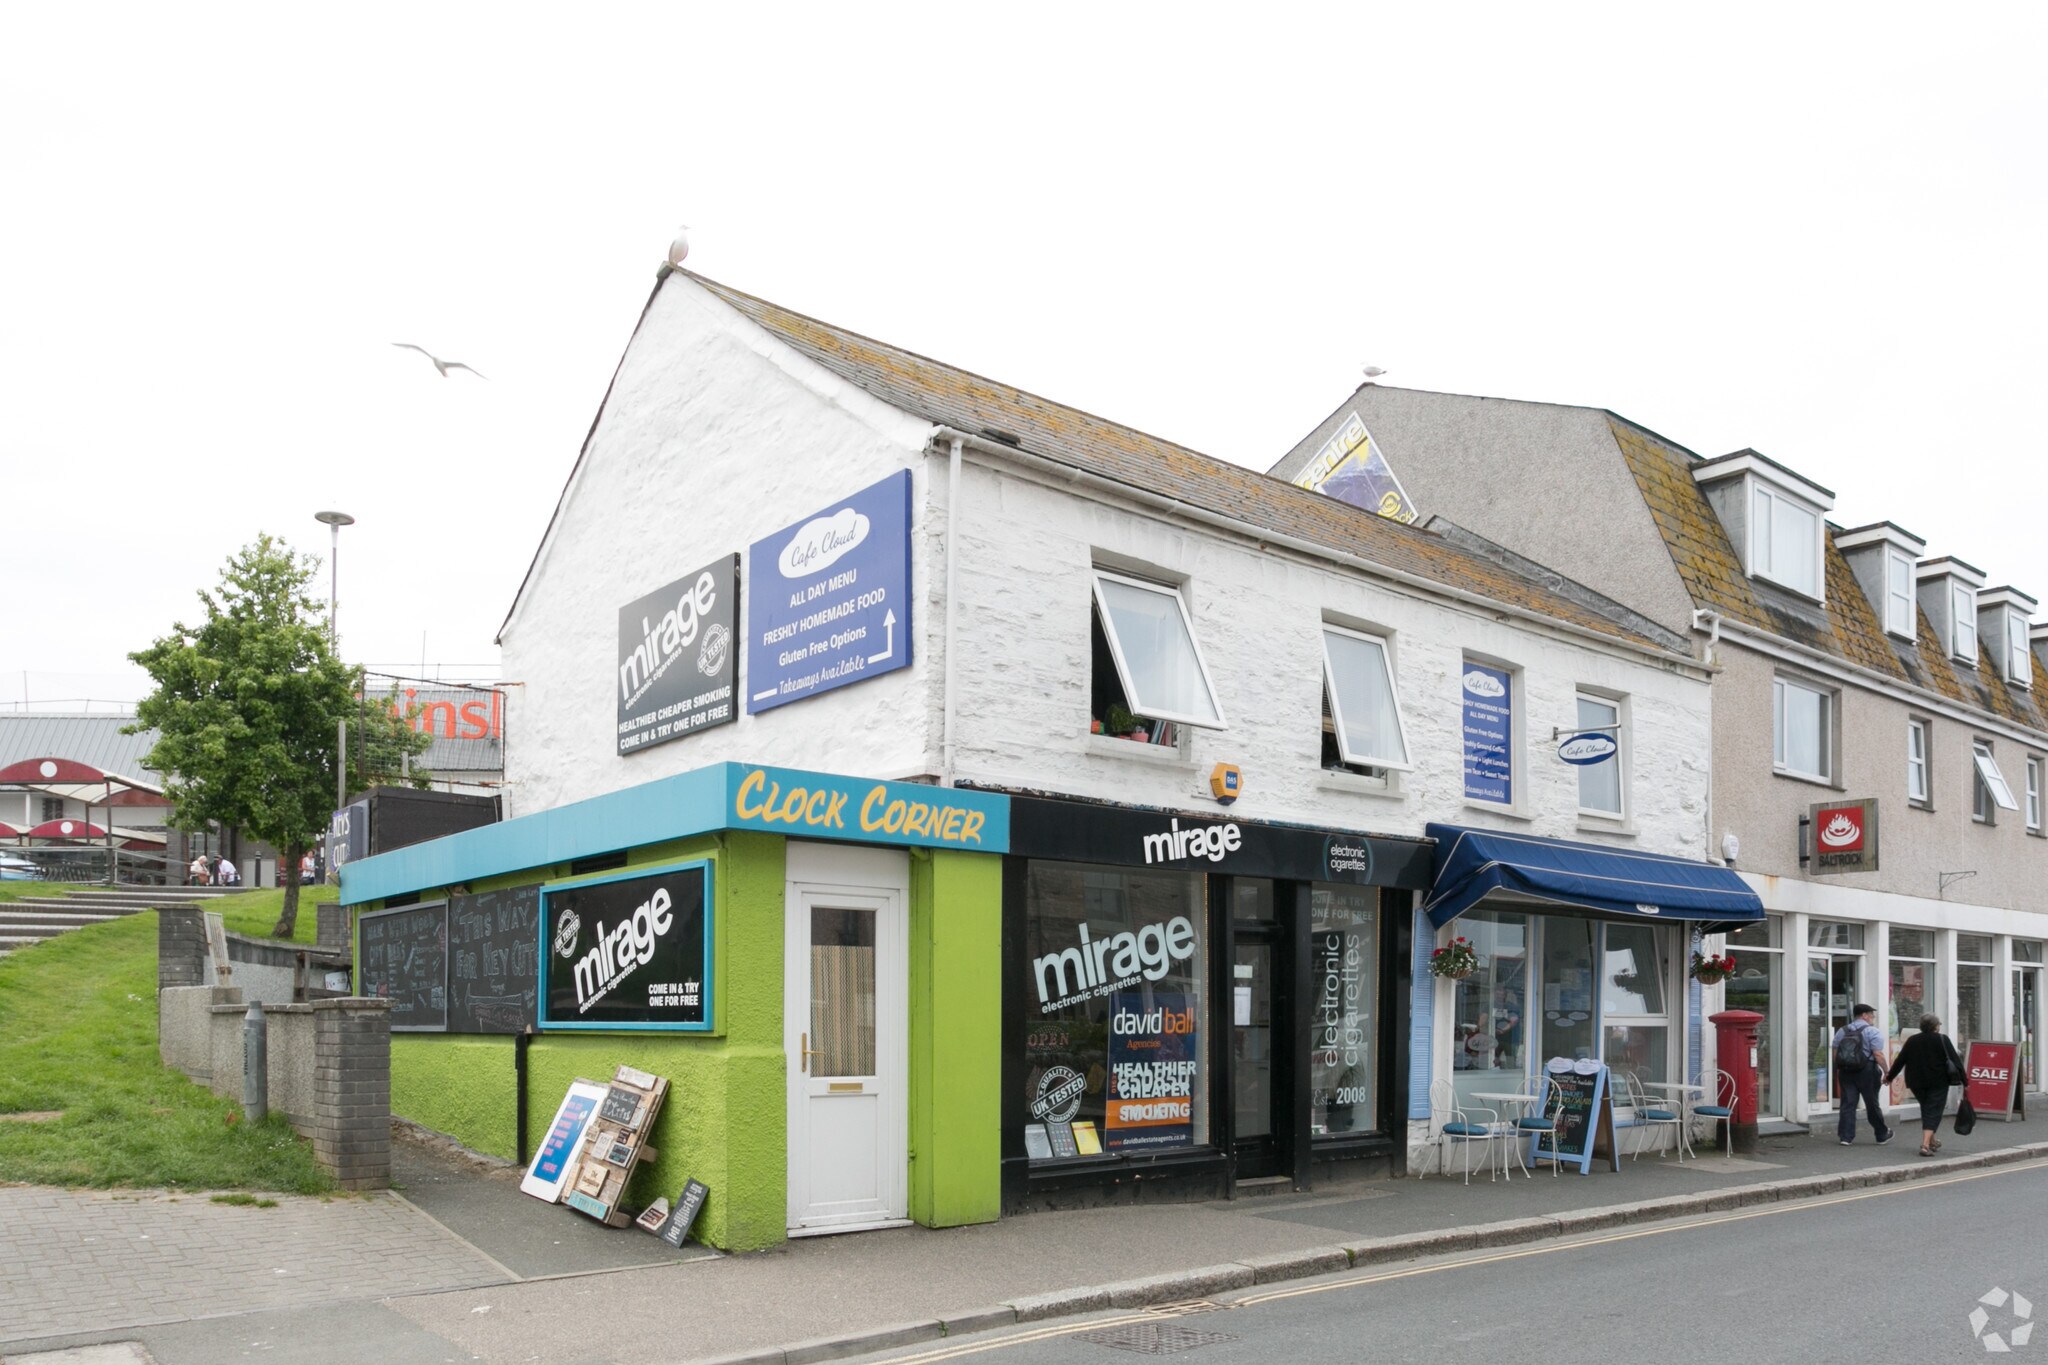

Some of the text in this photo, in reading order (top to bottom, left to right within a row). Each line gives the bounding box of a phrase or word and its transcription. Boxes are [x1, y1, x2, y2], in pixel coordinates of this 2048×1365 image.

[791, 519, 857, 567] Cafe Cloud
[789, 569, 857, 608] ALL DAY MENU
[763, 587, 886, 646] FRESHLY HOMEMADE FOOD
[620, 571, 716, 701] mirage
[707, 631, 729, 660] TESTED
[779, 626, 867, 667] Gluten Free Options
[779, 655, 865, 695] Takeaways Available
[619, 685, 731, 735] HEALTHIER CHEAPER SMOKING
[1478, 712, 1487, 720] DAY
[1487, 714, 1499, 723] MENU
[620, 704, 729, 750] COME IN & TRY ONE FOR FREE
[1464, 726, 1504, 740] Gluten Free Options
[1567, 744, 1583, 755] Cafe
[736, 769, 985, 845] CLOCK CORNER
[1143, 818, 1242, 864] mirage
[1330, 844, 1365, 859] electronic
[1330, 858, 1366, 872] cigarettes
[1819, 853, 1863, 867] SALTROCK
[459, 911, 492, 943] THIS
[496, 900, 530, 933] WAY
[1312, 907, 1374, 921] ONE FOR FREE
[456, 949, 478, 980] FOR
[482, 941, 509, 977] KEY
[573, 887, 673, 1004] mirage
[1033, 916, 1196, 1003] mirage
[607, 961, 638, 991] cigarettes
[648, 982, 700, 995] COME IN & TRY
[649, 994, 699, 1007] ONE FOR FREE
[1041, 975, 1142, 1014] electronic cigarettes
[1320, 934, 1340, 1067] electronic
[1341, 934, 1365, 1067] cigarettes
[1027, 1033, 1070, 1047] OPEN
[1126, 1039, 1162, 1051] Agencies
[1040, 1068, 1068, 1089] QUALITY
[1113, 1060, 1196, 1077] HEALTHIER
[1971, 1068, 2009, 1080] SALE
[1033, 1077, 1084, 1115] UK TESTED
[1120, 1083, 1190, 1099] CHEAPER
[1336, 1086, 1367, 1105] 2008
[1120, 1102, 1191, 1122] SMOKING
